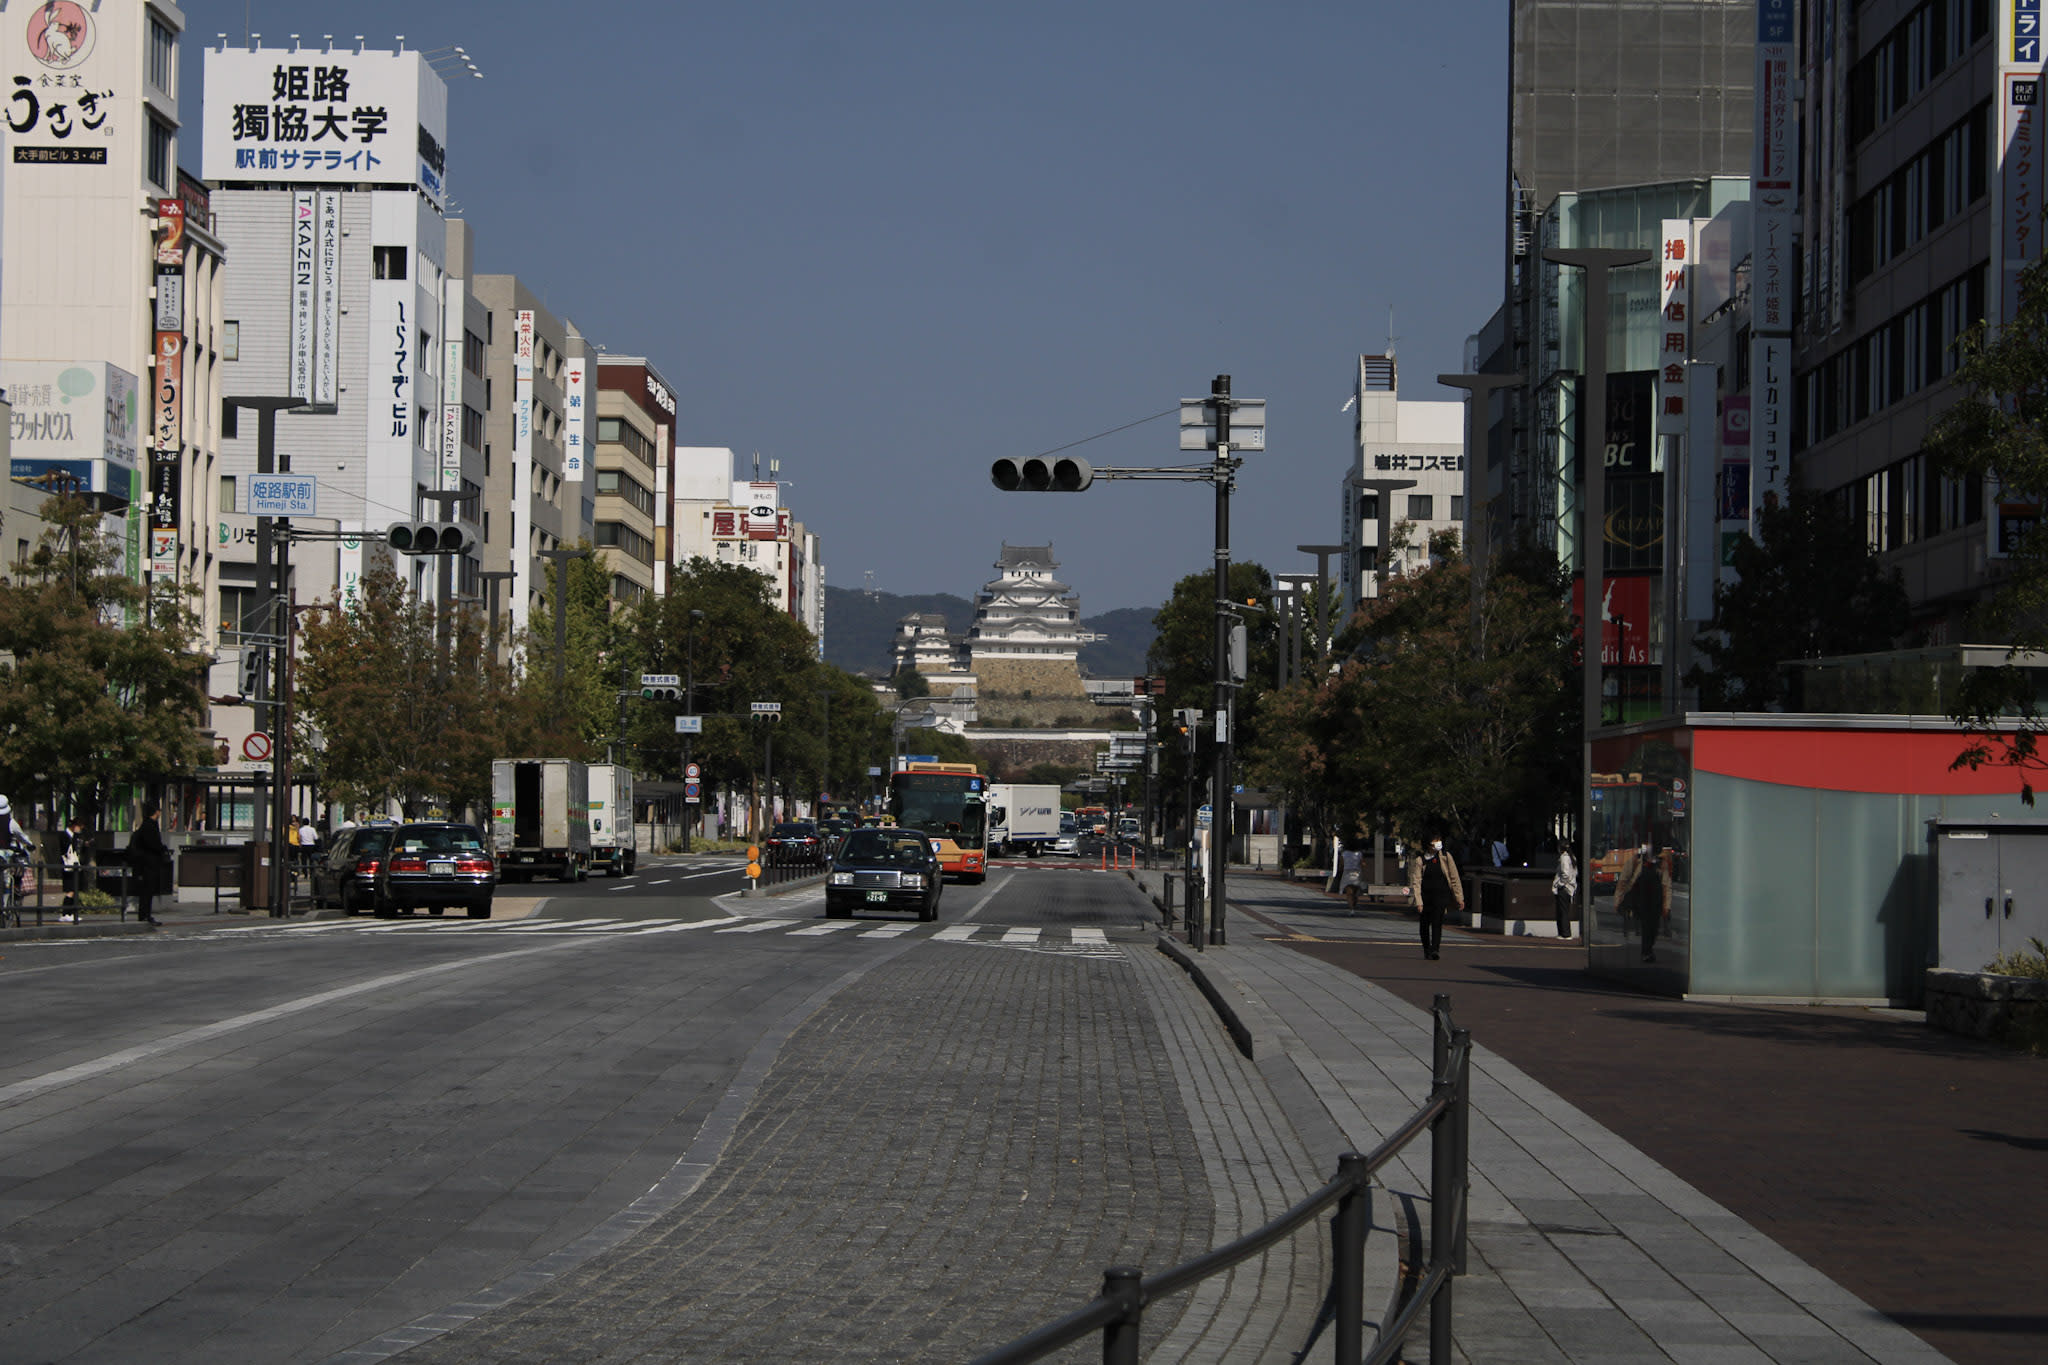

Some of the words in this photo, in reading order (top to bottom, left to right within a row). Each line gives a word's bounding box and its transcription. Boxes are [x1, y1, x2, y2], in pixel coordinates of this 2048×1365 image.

[272, 64, 350, 103] 姫路
[5, 75, 114, 139] うさぎ
[232, 104, 387, 143] 獨協大学
[1773, 60, 1786, 176] 湘南美容クリニック
[17, 149, 69, 161] 大手前ビル
[235, 147, 381, 171] 駅前サテライト
[298, 195, 312, 285] TAKAZEN
[1766, 219, 1780, 324] シースラボ姫路
[520, 312, 531, 358] 共栄火災
[1664, 239, 1686, 415] 播州信用金庫
[8, 384, 52, 406] 賃貸・売買
[160, 378, 176, 441] うさぎ
[520, 399, 529, 437] アフラック
[1765, 345, 1779, 483] トレカショップ
[446, 408, 454, 458] TAKAZEN
[569, 395, 581, 469] 第一生命
[253, 481, 311, 499] 姫路駅前
[257, 499, 287, 511] Himeji
[289, 499, 308, 510] Sta.
[1236, 784, 1242, 792] P
